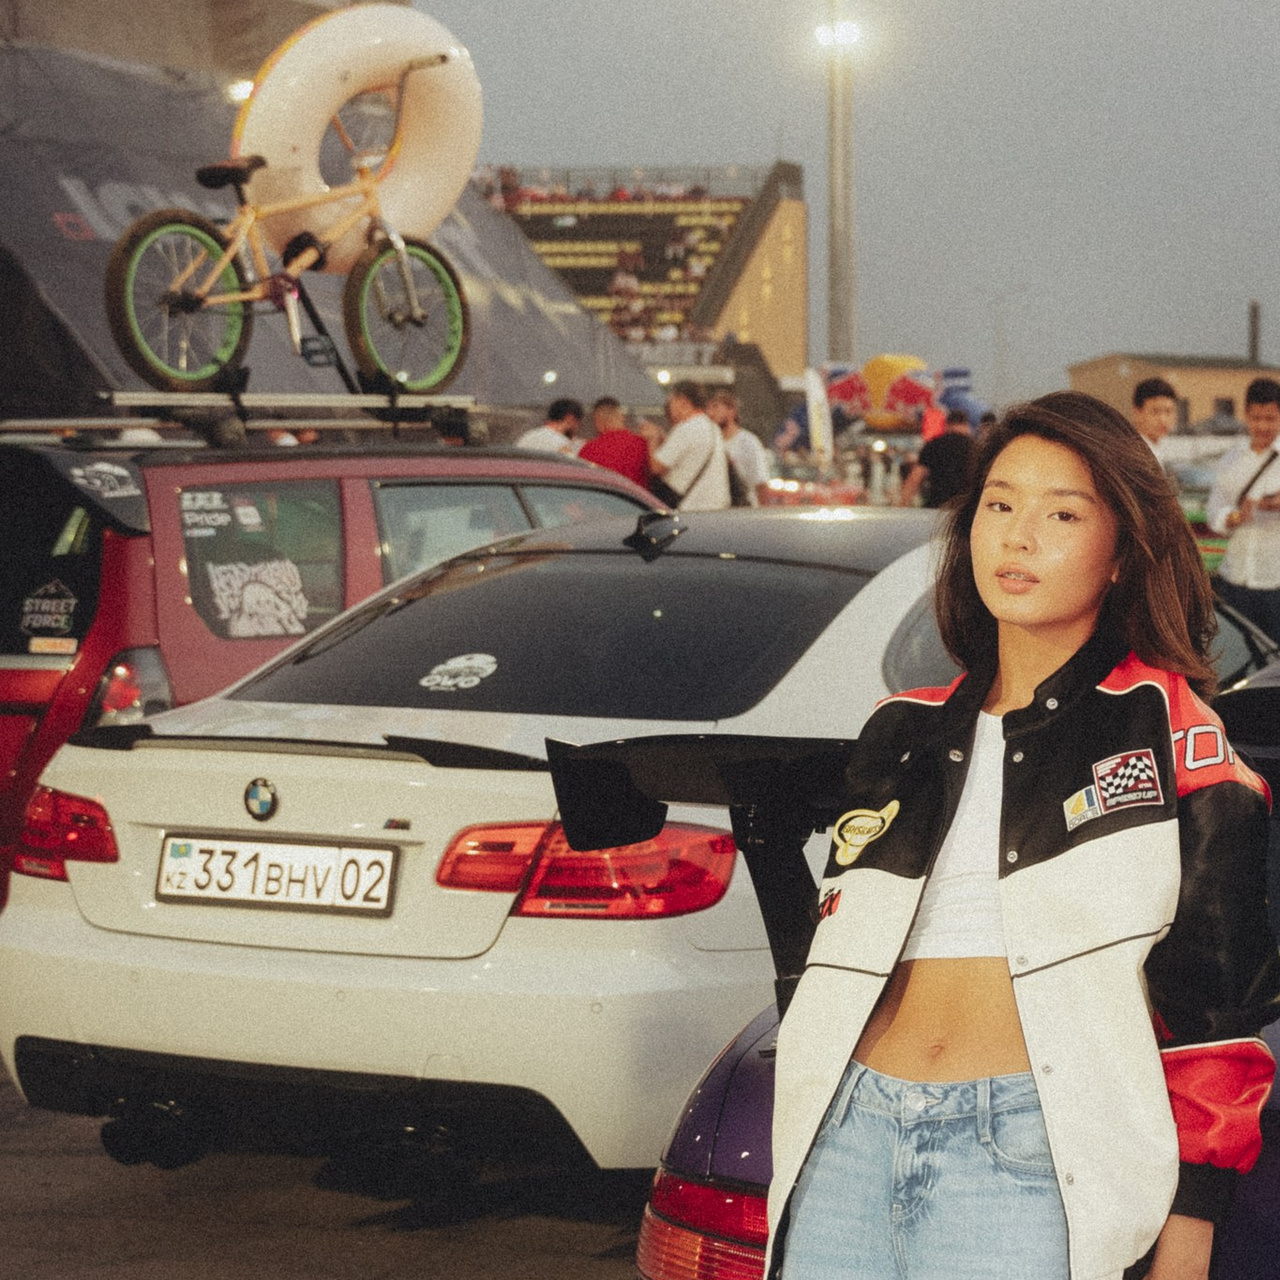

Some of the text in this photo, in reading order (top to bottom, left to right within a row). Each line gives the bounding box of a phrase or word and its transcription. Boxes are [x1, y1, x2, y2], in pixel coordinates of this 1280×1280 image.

[22, 598, 78, 613] STREET
[23, 614, 72, 628] FORCE
[165, 872, 188, 890] KZ
[341, 859, 385, 903] 02
